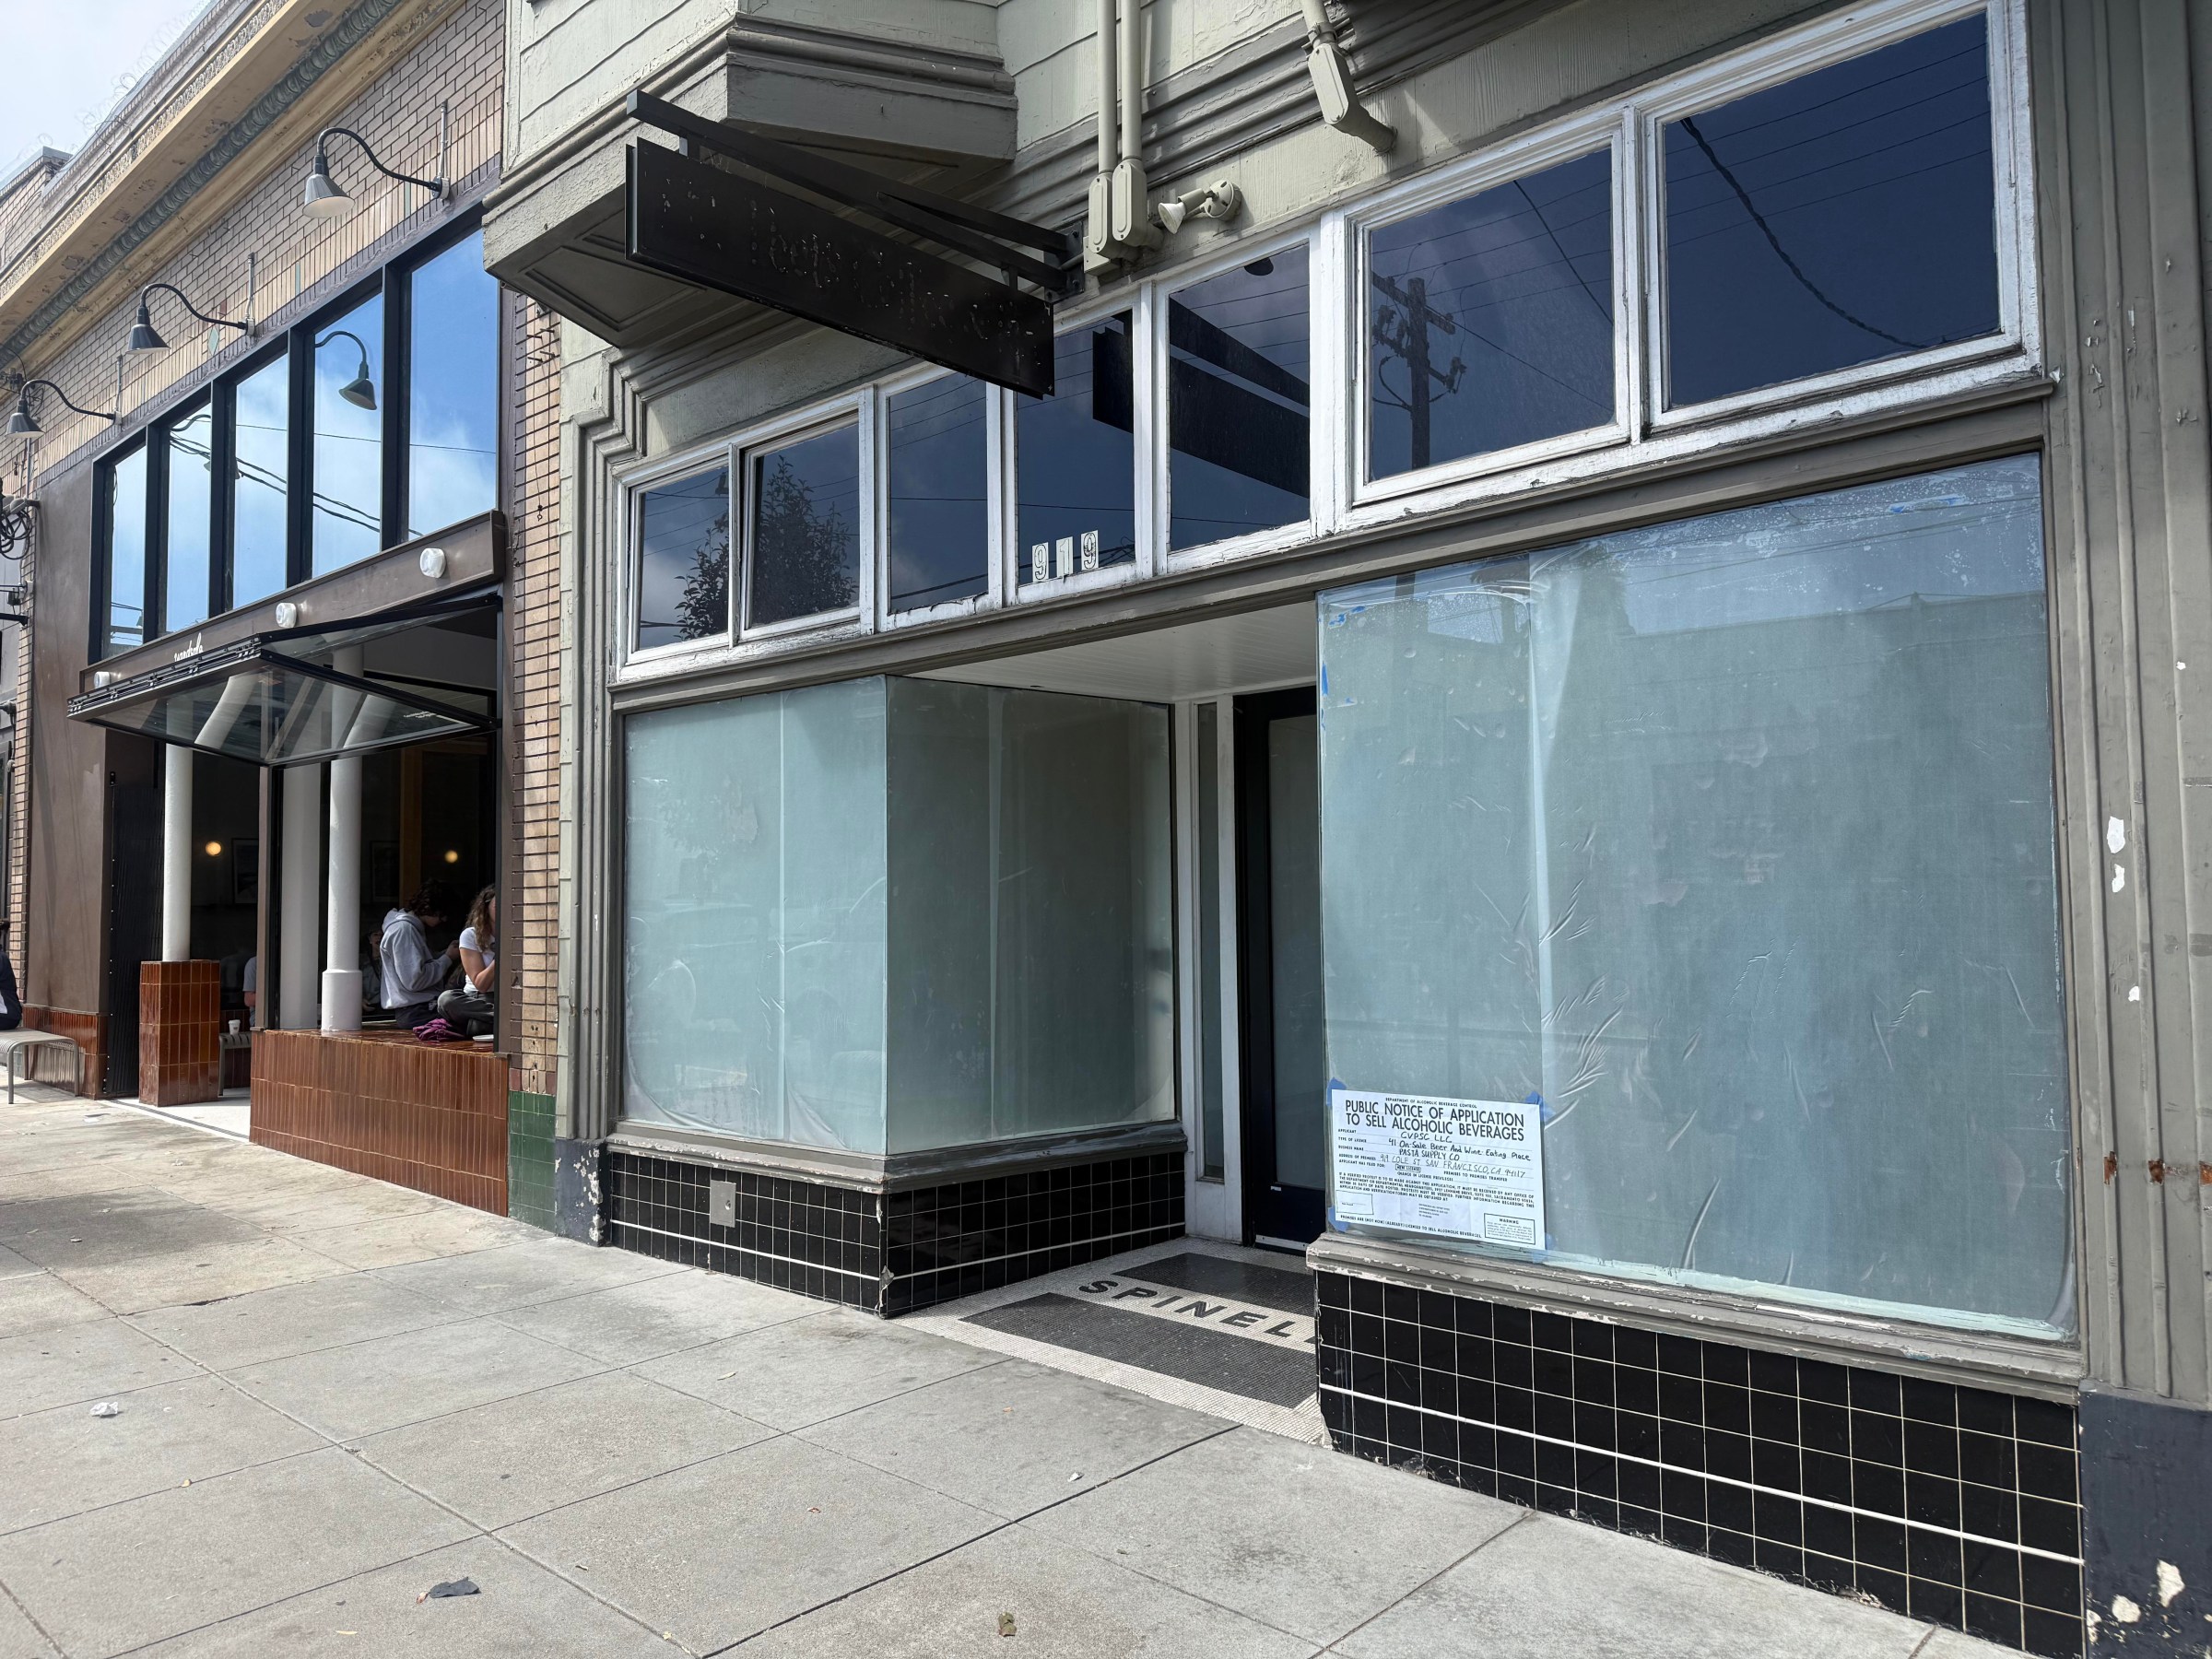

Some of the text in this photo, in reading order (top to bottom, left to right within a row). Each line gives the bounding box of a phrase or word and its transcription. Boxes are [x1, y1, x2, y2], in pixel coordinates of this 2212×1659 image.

[1033, 531, 1097, 582] 919
[1346, 1100, 1524, 1127] PUBLIC NOTICE OF APPLICATION
[1346, 1112, 1524, 1141] TO SELL ALCOHOLIC BEVERAGES
[1401, 1131, 1452, 1143] CVPSC LLC
[1388, 1137, 1396, 1147] 41
[1399, 1140, 1427, 1149] On-Sale
[1430, 1143, 1447, 1151] Beer
[1450, 1144, 1462, 1153] And
[1486, 1149, 1506, 1159] Eating
[1512, 1152, 1531, 1161] Place
[1399, 1148, 1460, 1161] PASTA SUPPLY CO
[1392, 1155, 1409, 1164] COLE
[1426, 1159, 1439, 1168] SAN
[1504, 1169, 1525, 1178] 94117
[1078, 1279, 1316, 1344] SPINEL
